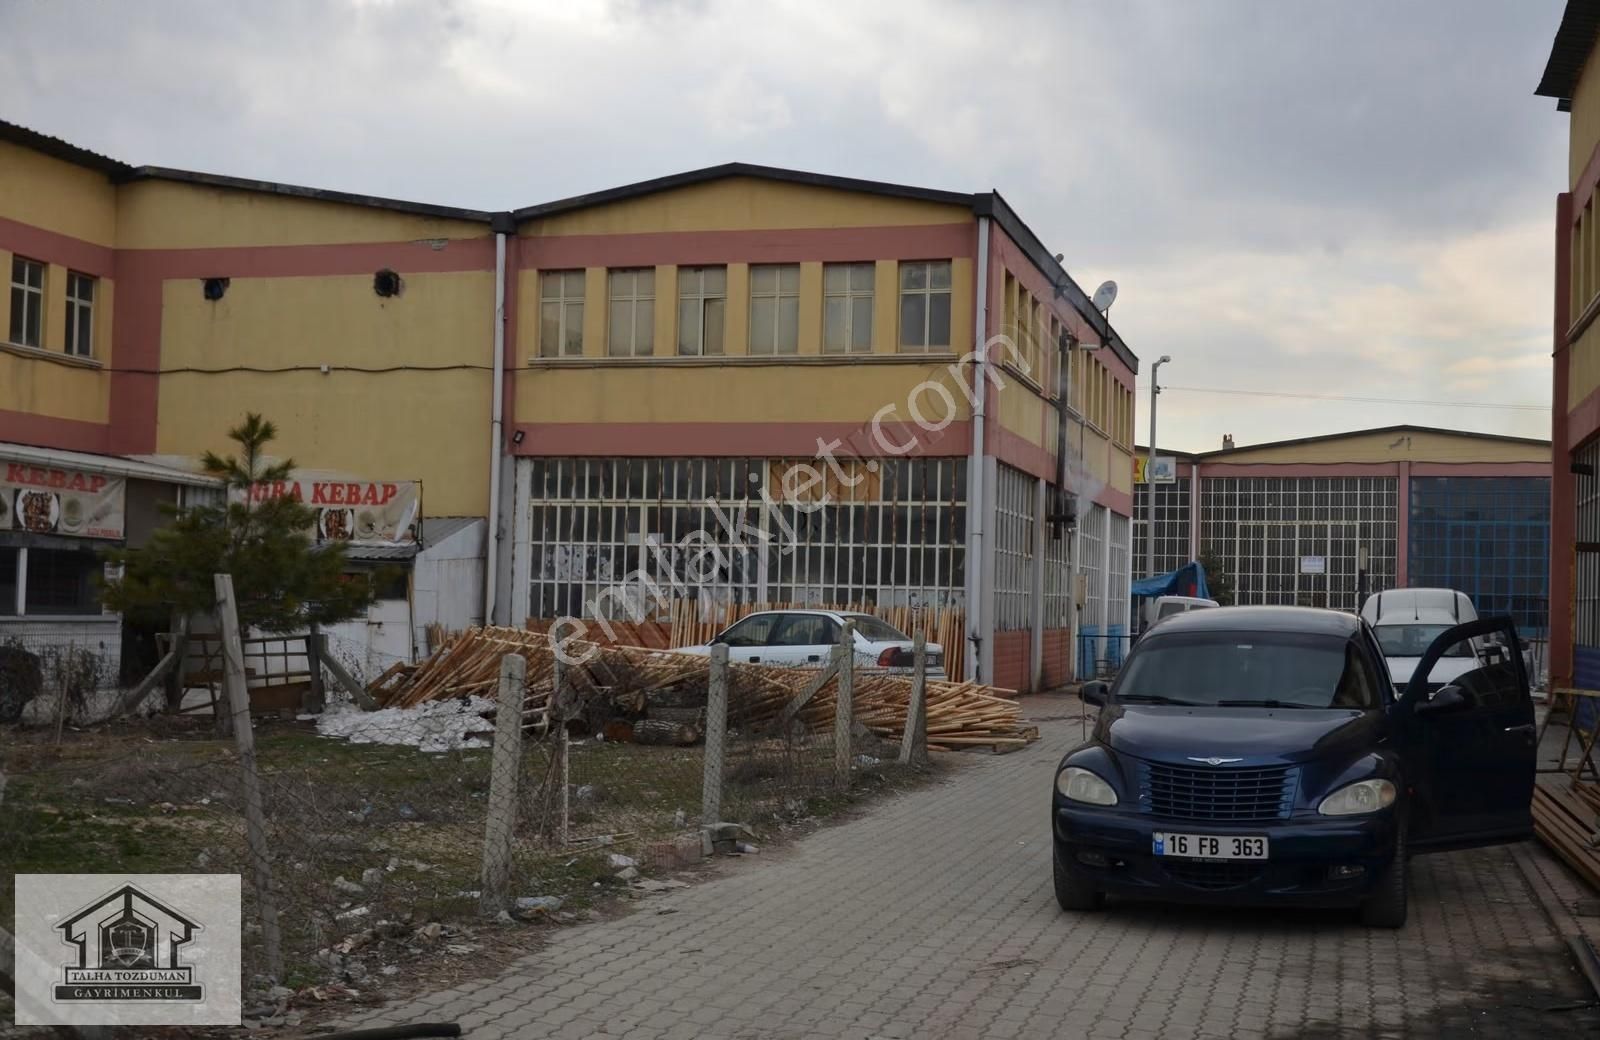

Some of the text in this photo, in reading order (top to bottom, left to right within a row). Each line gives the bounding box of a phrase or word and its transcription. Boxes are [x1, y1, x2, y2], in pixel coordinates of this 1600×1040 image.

[6, 463, 107, 494] KEBAP
[311, 482, 398, 506] KEBAP
[1169, 835, 1188, 854] 16
[1198, 837, 1219, 856] FB
[1232, 838, 1264, 857] 363
